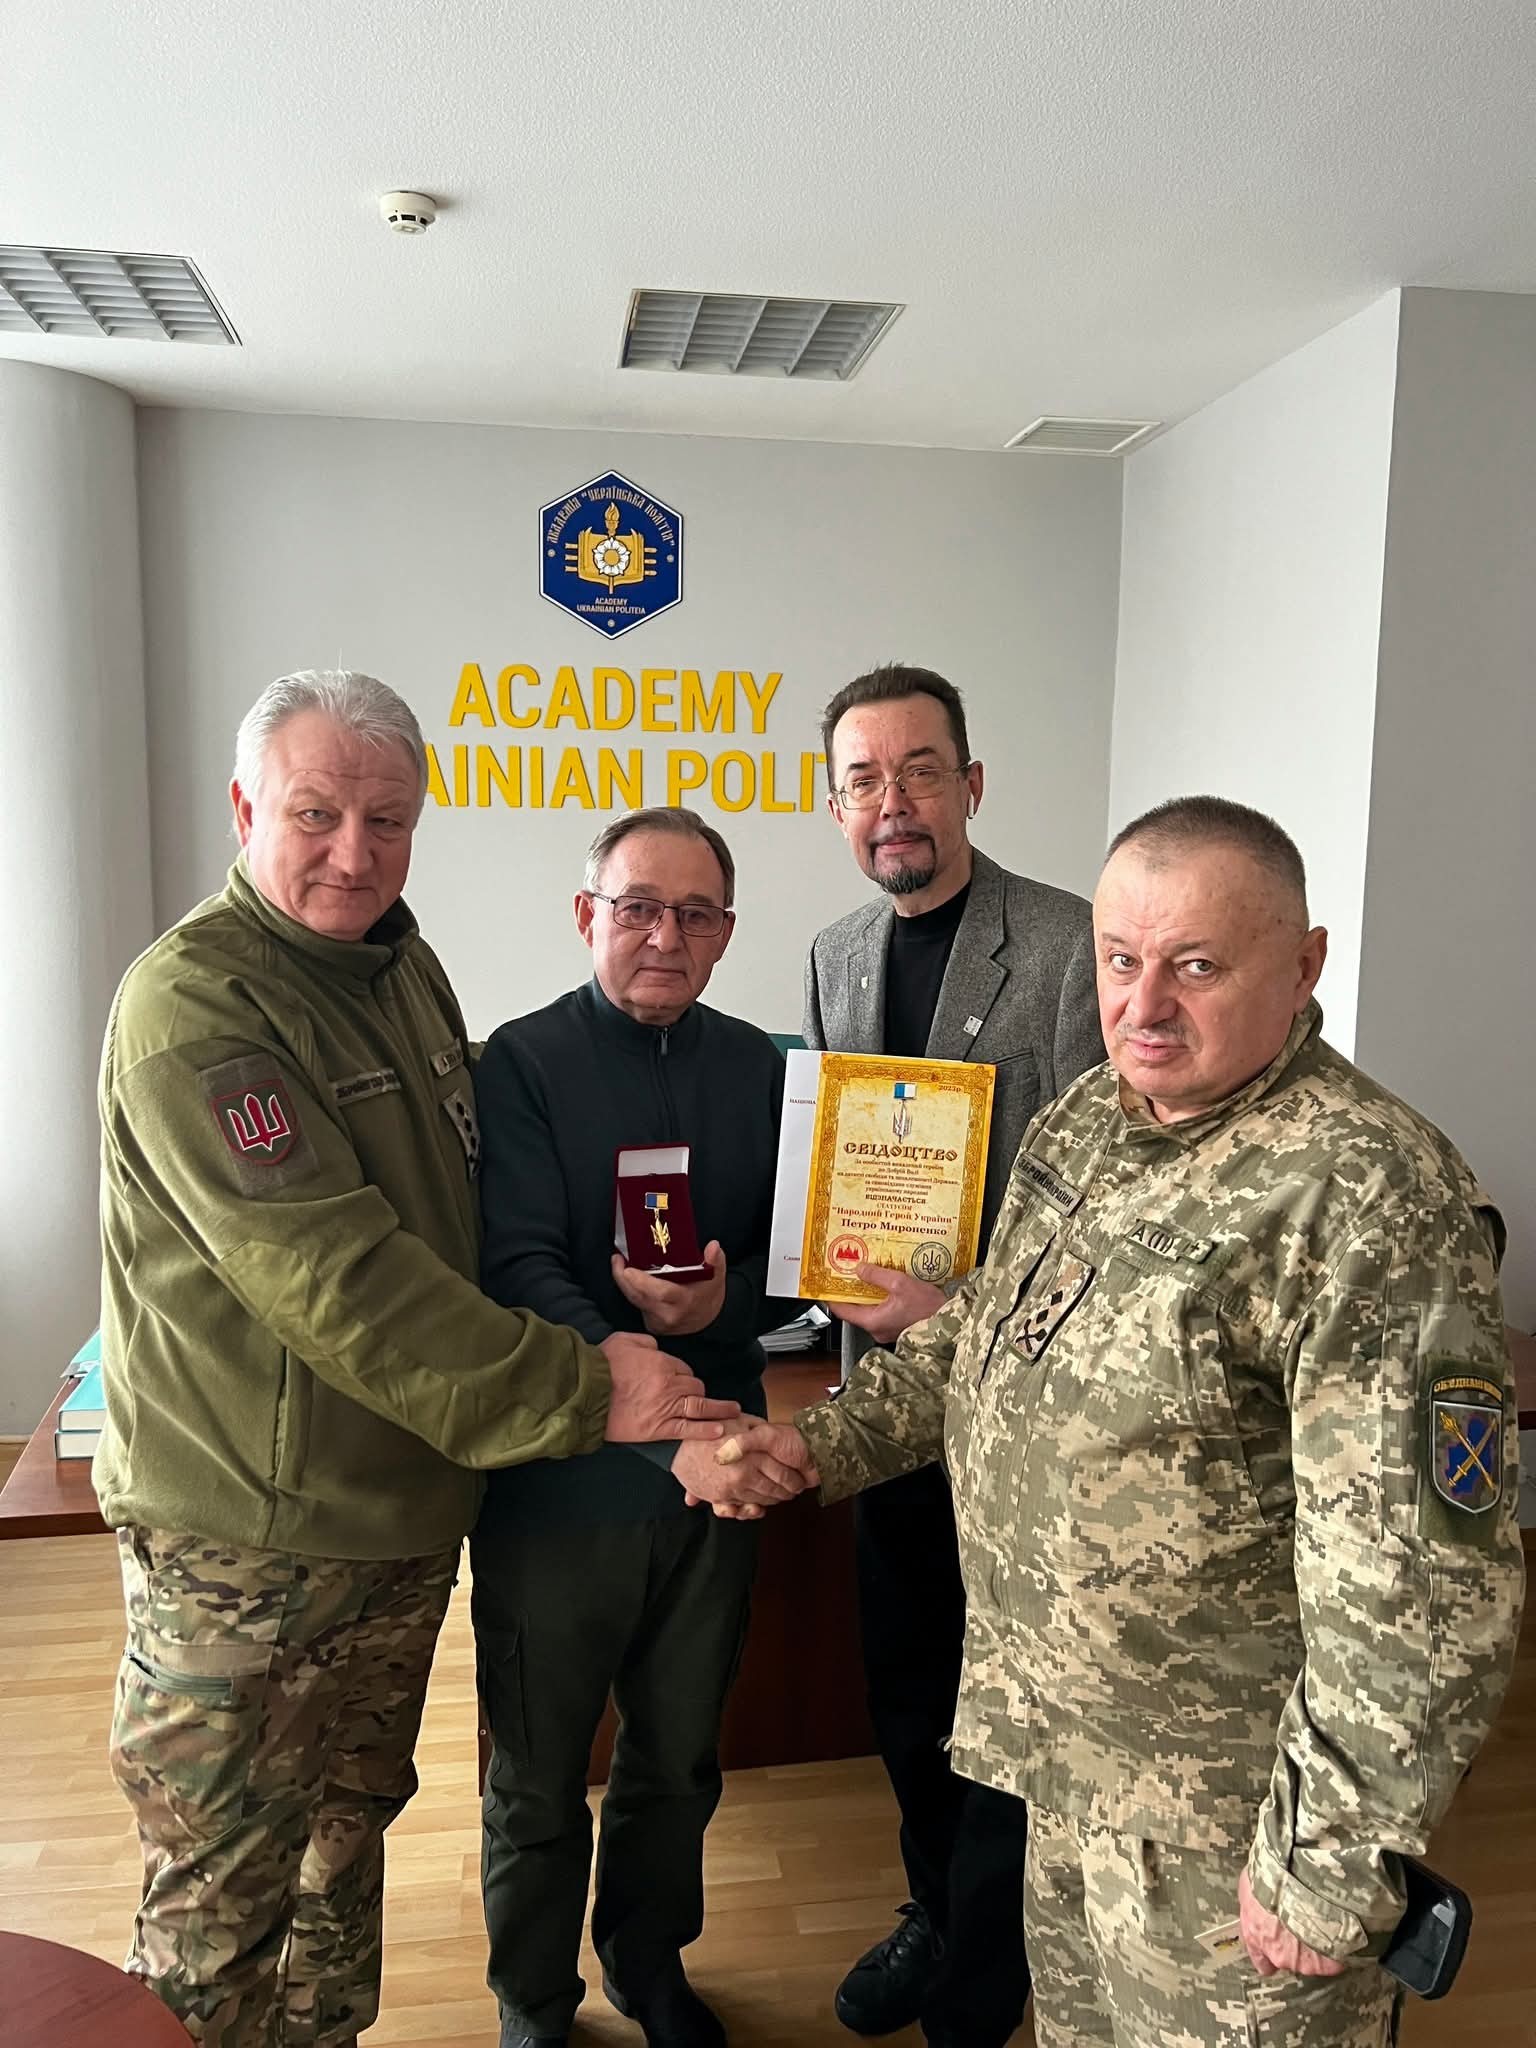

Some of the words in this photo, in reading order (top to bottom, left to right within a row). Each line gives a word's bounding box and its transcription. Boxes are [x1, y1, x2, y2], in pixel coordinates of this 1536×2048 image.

[577, 605, 614, 613] UKRAINIAN
[616, 606, 645, 614] POLITEIA
[448, 663, 783, 734] ACADEMY
[844, 1142, 957, 1161] СВІДОЦТВО
[832, 1207, 882, 1217] "Народний
[885, 1211, 912, 1220] Герой
[914, 1213, 957, 1223] України"
[841, 1219, 877, 1229] Петро
[880, 1222, 947, 1236] Мироненко
